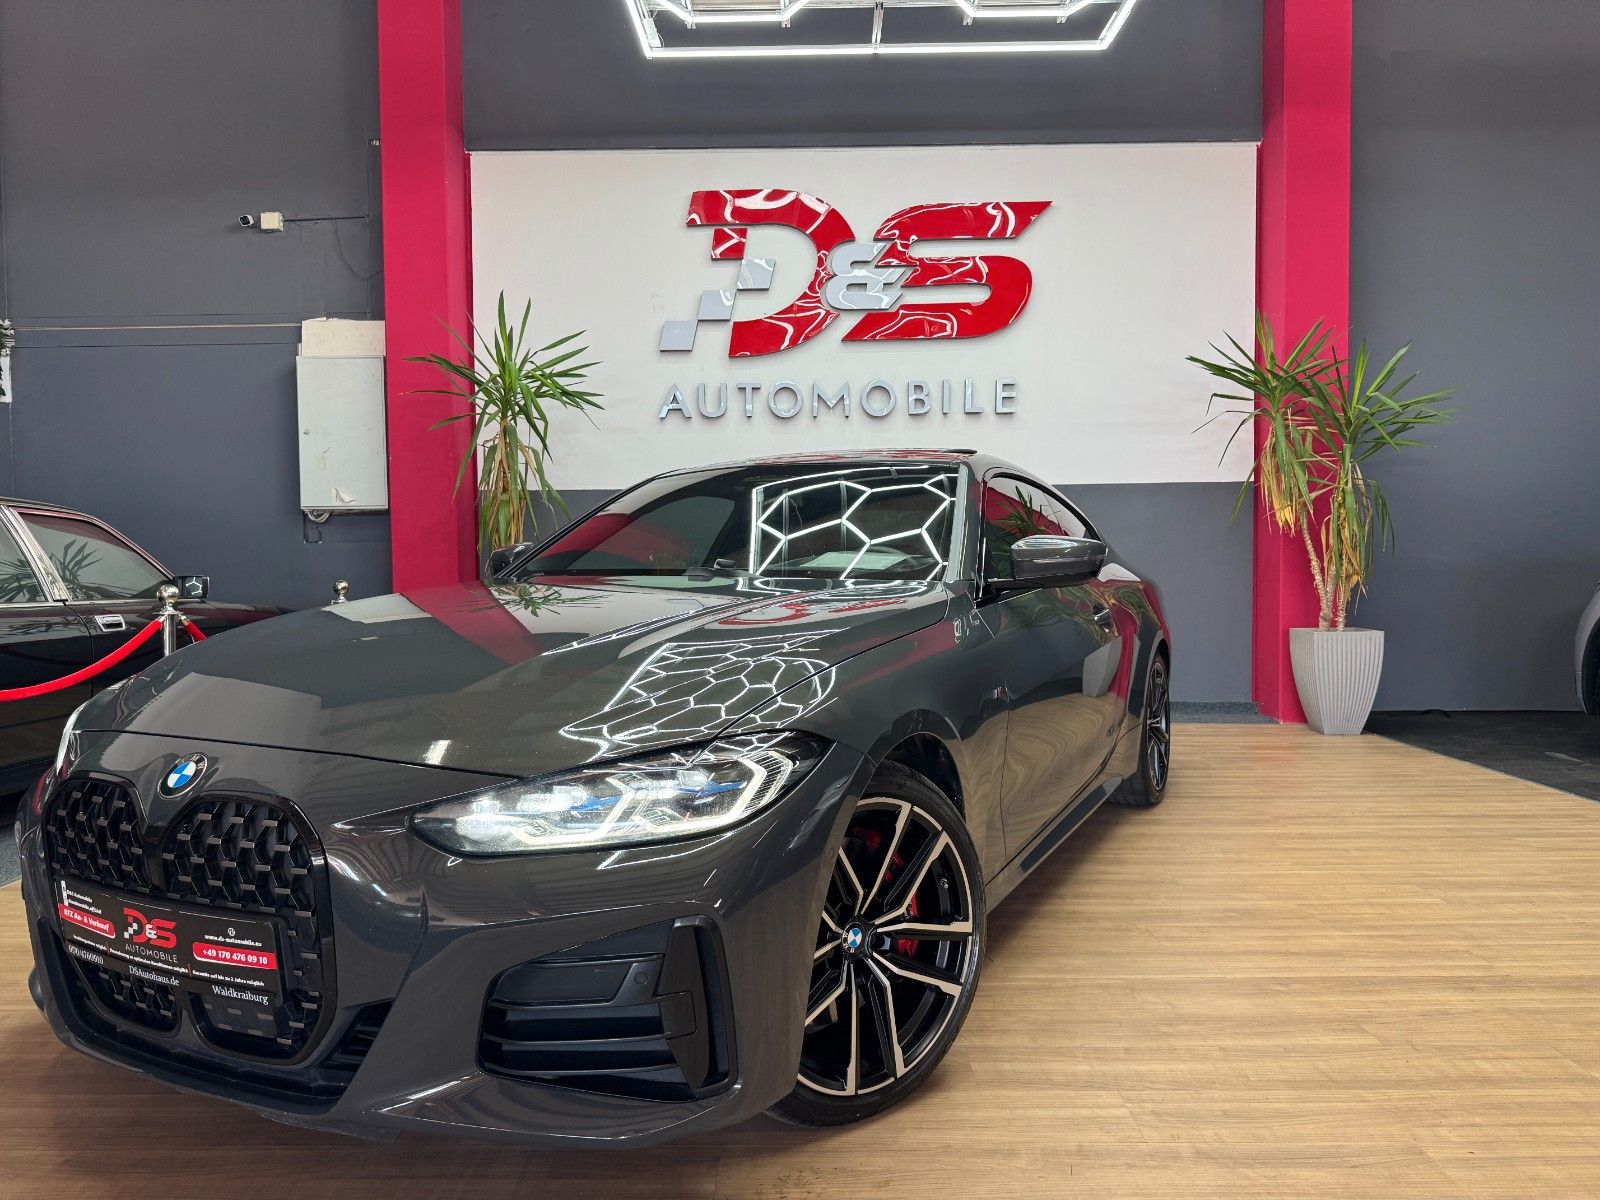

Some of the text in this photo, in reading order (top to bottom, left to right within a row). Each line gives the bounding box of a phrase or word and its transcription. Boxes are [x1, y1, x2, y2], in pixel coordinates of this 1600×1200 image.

[659, 188, 1054, 358] D&S
[658, 376, 1019, 419] AUTOMOBILE
[63, 908, 74, 918] KFZ
[123, 907, 177, 949] D&S
[125, 943, 179, 963] AUTOMOBILE
[203, 948, 268, 965] +49 170 476 09 10
[128, 965, 180, 987] DSAutohaus.de
[210, 984, 269, 1006] Waldkraiburg
